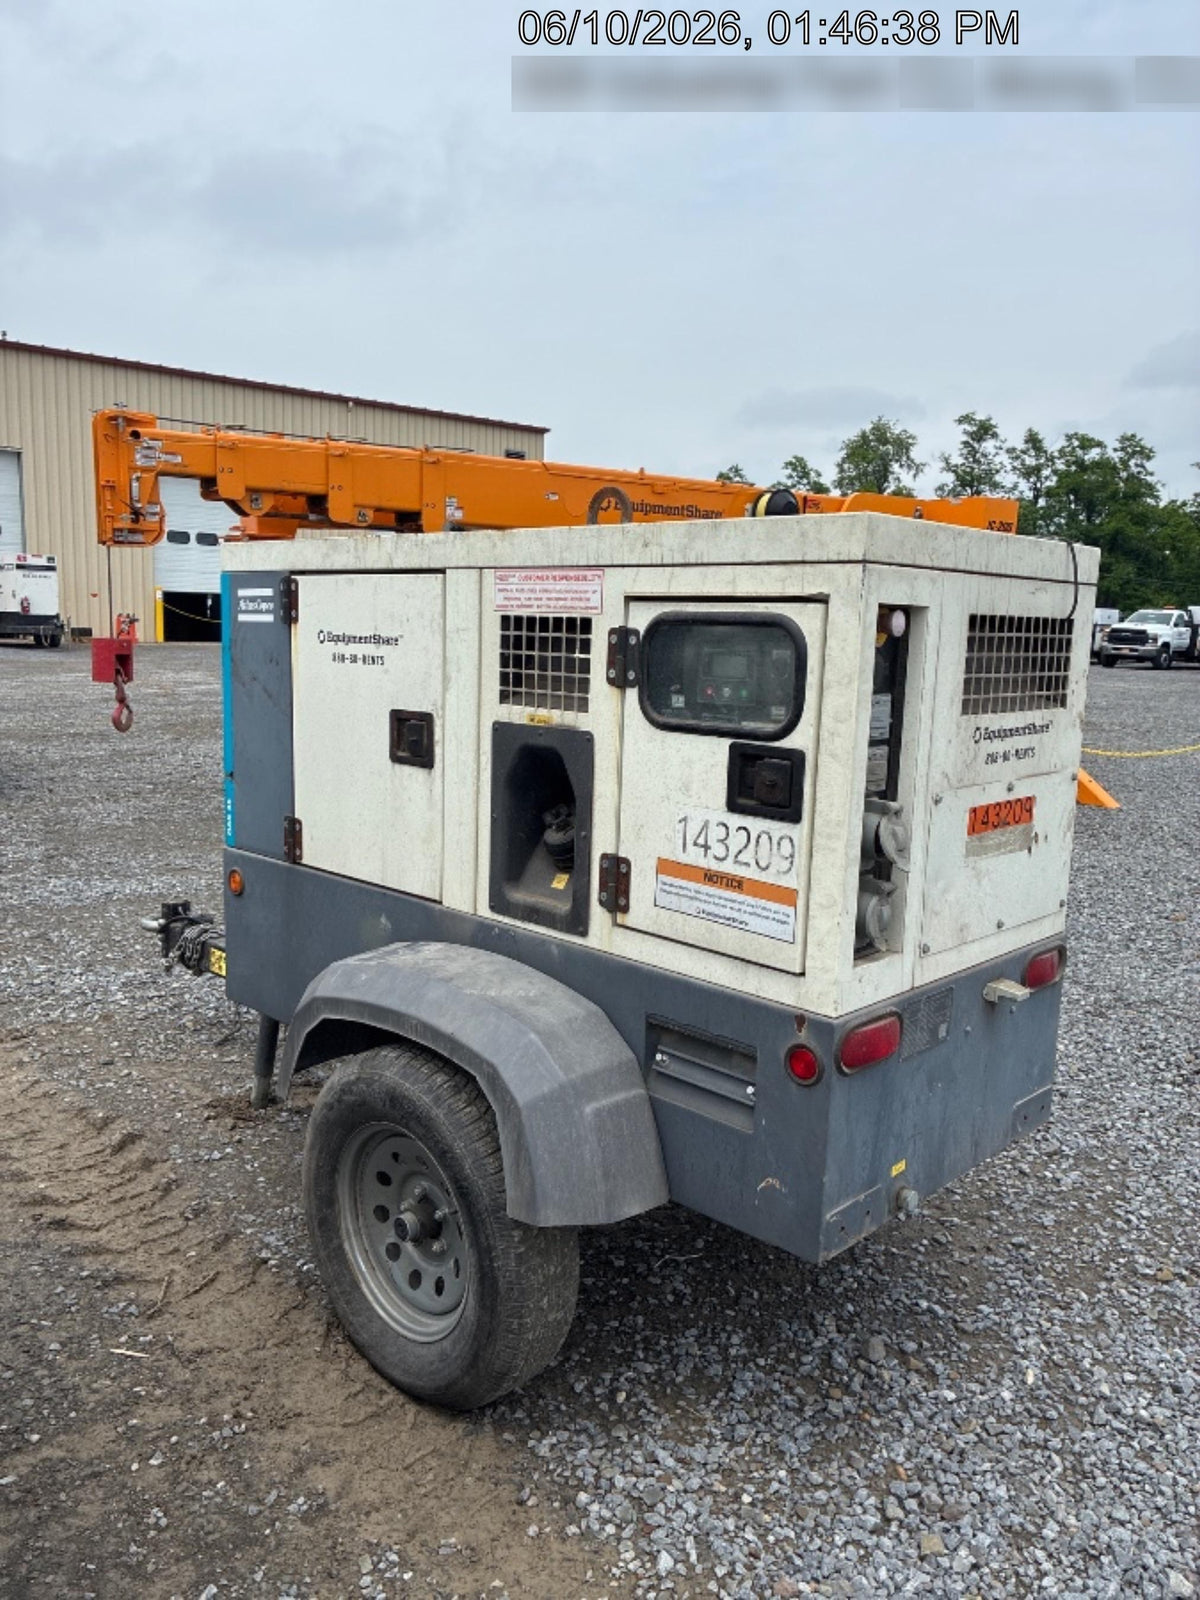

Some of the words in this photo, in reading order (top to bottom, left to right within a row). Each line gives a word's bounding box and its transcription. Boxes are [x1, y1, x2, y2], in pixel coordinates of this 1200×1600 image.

[326, 631, 399, 646] EquipmentShare
[971, 797, 1033, 833] 143209
[678, 816, 796, 874] 143209
[703, 872, 744, 891] NOTICE
